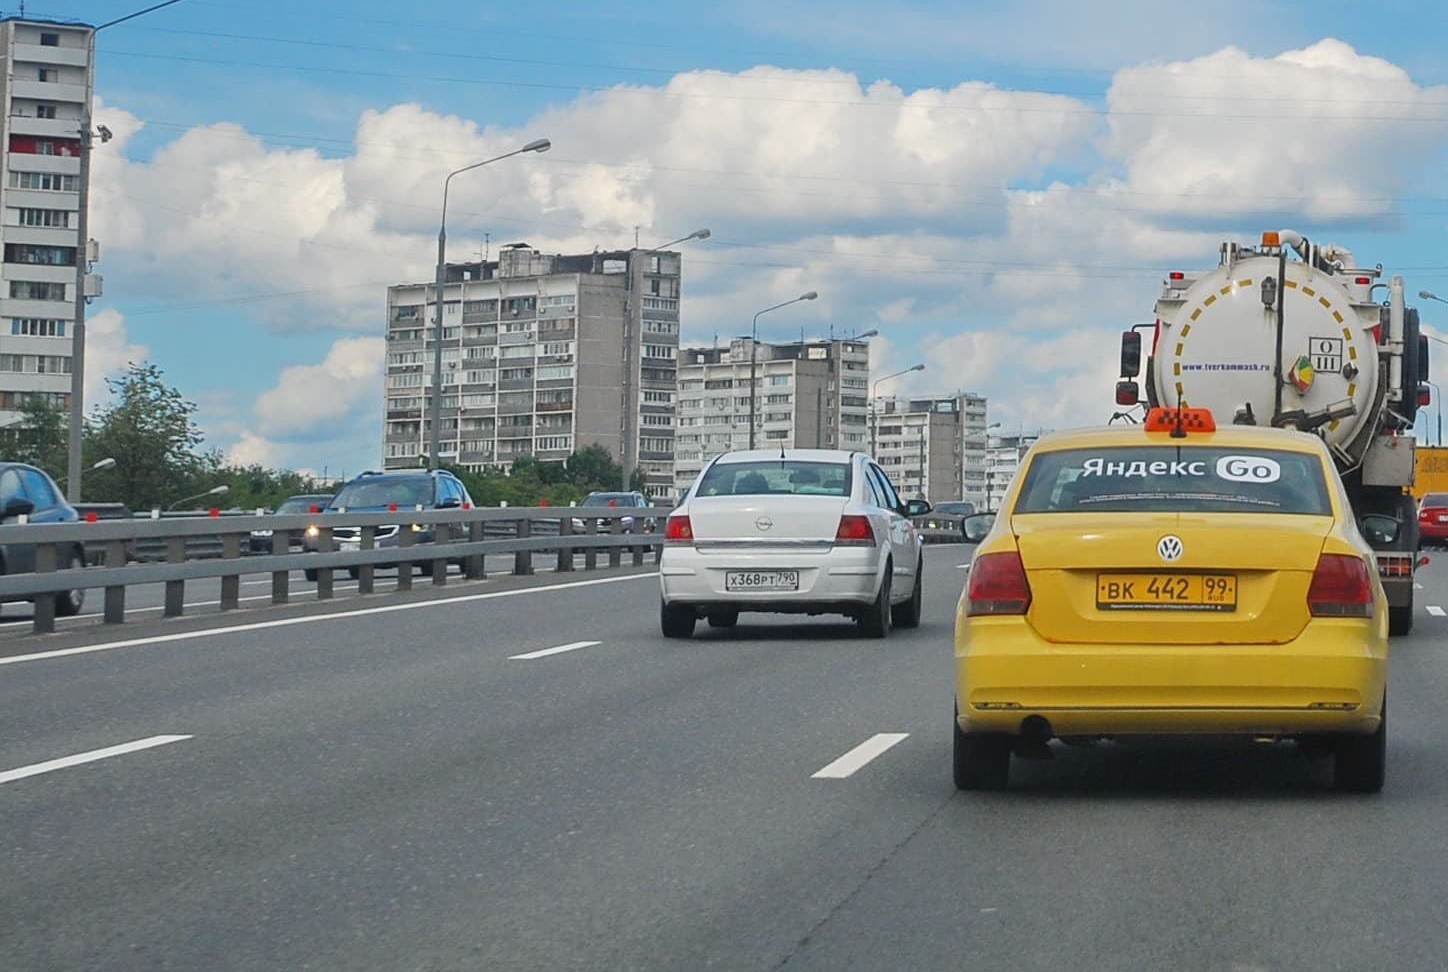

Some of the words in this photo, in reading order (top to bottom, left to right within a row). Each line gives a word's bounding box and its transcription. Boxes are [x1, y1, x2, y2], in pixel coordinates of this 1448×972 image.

[1083, 458, 1205, 477] Яндекс
[1225, 459, 1272, 478] Go
[1147, 577, 1189, 600] 442
[1205, 578, 1227, 595] 99
